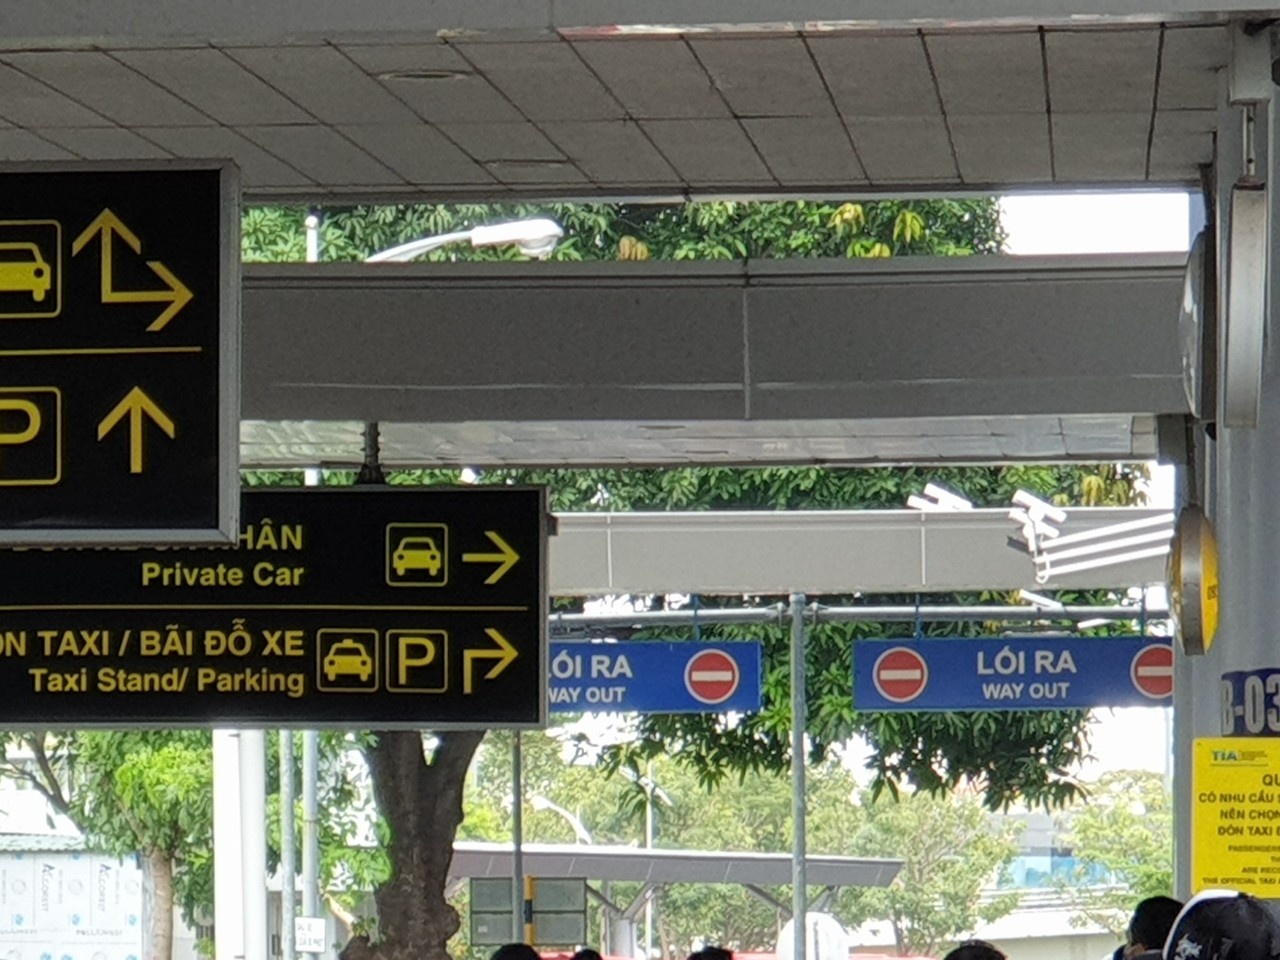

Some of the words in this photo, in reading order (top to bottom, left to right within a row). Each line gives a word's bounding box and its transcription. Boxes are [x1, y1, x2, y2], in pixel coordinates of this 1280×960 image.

[238, 523, 302, 550] HÂN
[142, 562, 244, 586] Private
[253, 561, 305, 587] Car
[39, 630, 109, 656] TAXI
[140, 625, 193, 656] BÃI
[204, 619, 252, 657] ĐỖ
[263, 630, 305, 656] XE
[591, 654, 633, 679] RA
[1035, 650, 1077, 674] RA
[31, 668, 88, 692] Taxi
[97, 667, 189, 692] Stand/
[197, 667, 305, 698] Parking
[585, 686, 626, 704] OUT
[982, 683, 1024, 699] WAY
[1029, 682, 1070, 699] OUT
